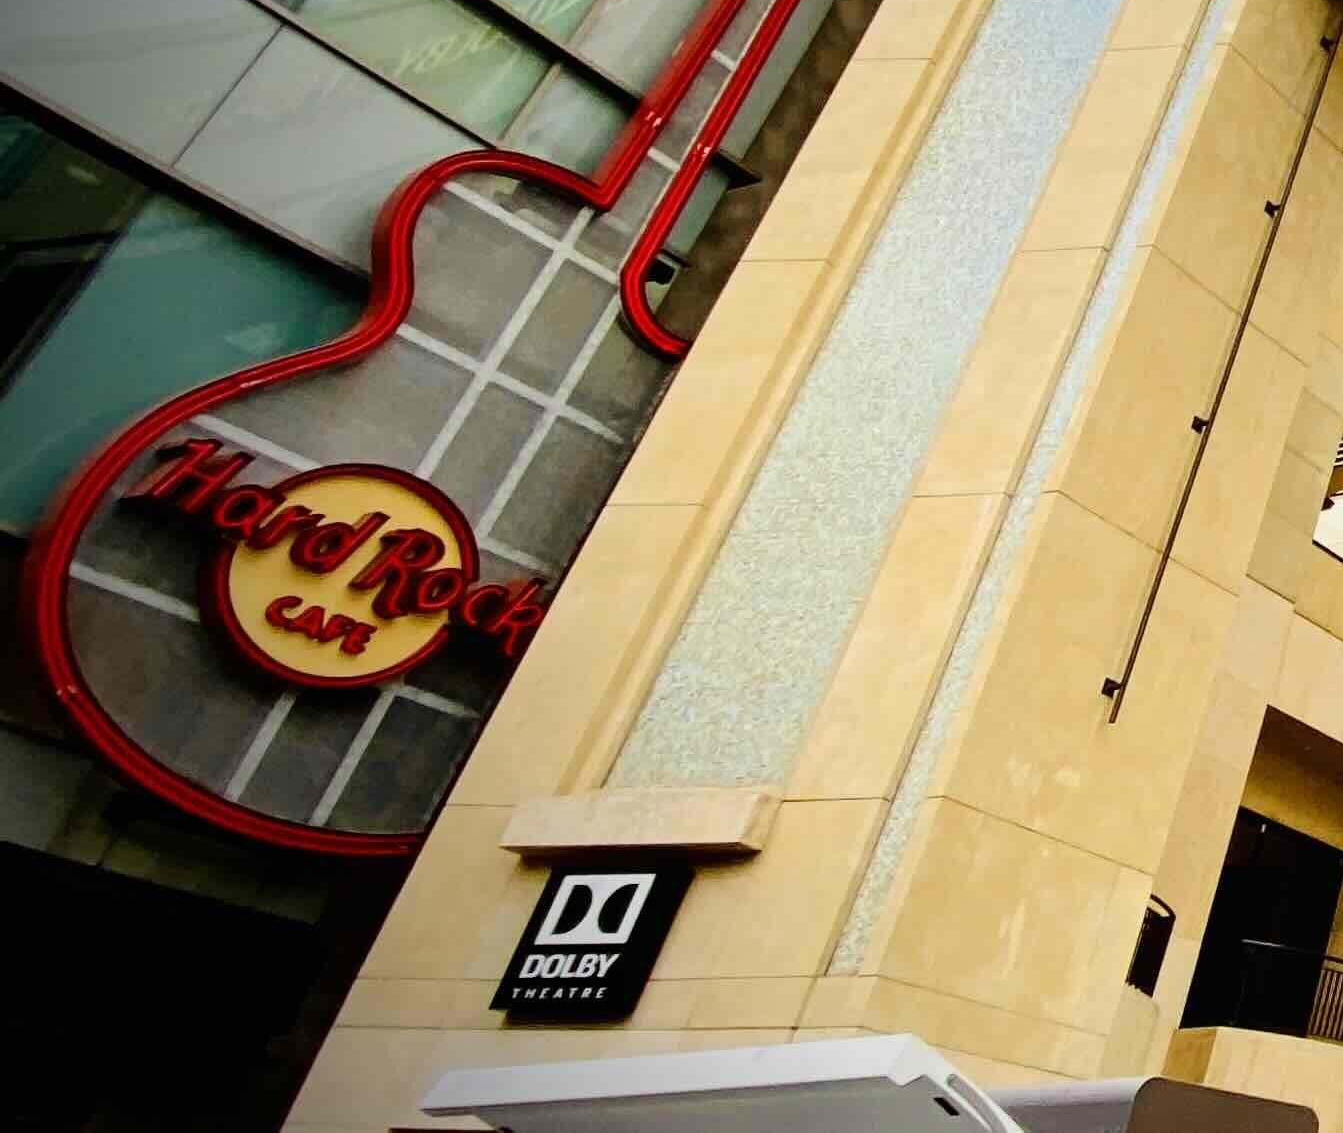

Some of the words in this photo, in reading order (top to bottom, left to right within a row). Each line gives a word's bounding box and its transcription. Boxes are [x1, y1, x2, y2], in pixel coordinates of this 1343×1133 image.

[142, 438, 390, 574] Hard
[347, 528, 545, 658] Rock
[518, 952, 621, 979] DOLBY
[511, 986, 609, 999] THEATRE
